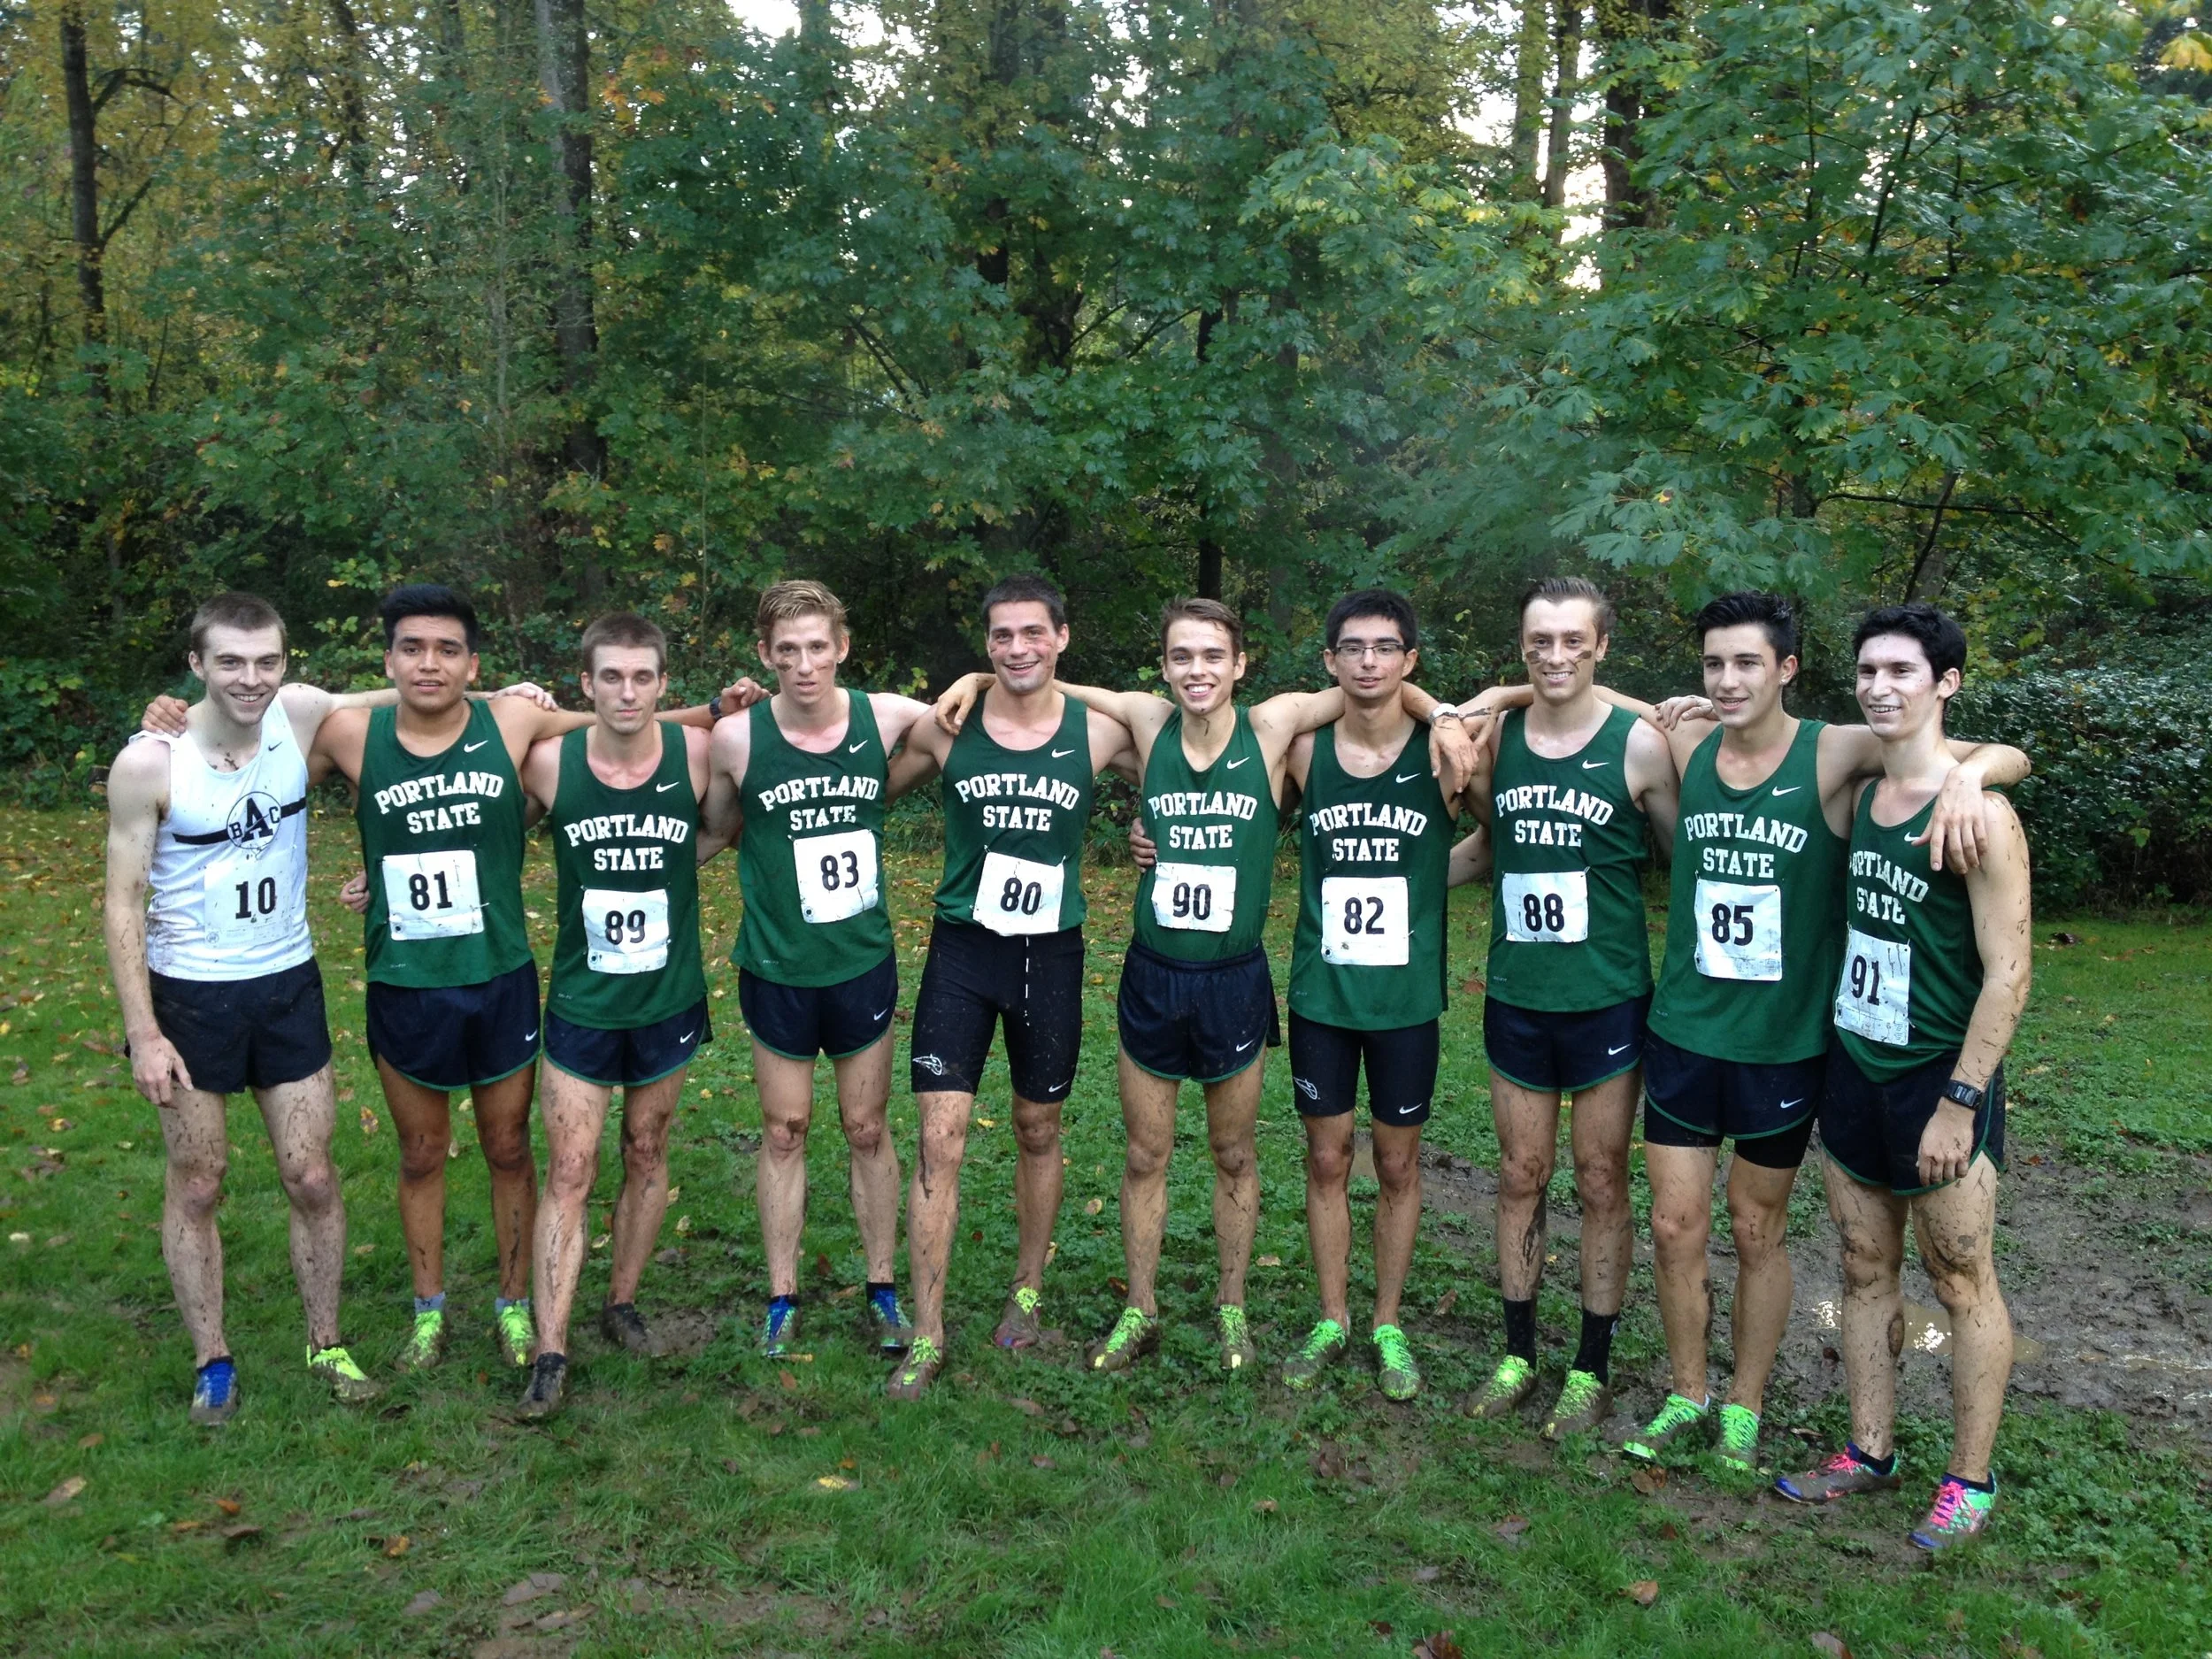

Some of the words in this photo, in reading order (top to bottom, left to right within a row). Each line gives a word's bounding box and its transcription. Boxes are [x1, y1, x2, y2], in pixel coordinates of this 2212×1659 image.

[374, 772, 504, 815] PORTLAND
[758, 775, 879, 812] PORTLAND
[955, 773, 1080, 810] PORTLAND
[1148, 791, 1258, 821] PORTLAND
[1495, 784, 1614, 826] PORTLAND
[407, 803, 481, 834] STATE
[564, 813, 689, 848] PORTLAND
[789, 804, 856, 832] STATE
[983, 805, 1052, 832] STATE
[1310, 803, 1428, 837] PORTLAND
[1514, 819, 1582, 848] STATE
[1685, 812, 1809, 854] PORTLAND
[1169, 825, 1233, 850] STATE
[1332, 837, 1400, 862] STATE
[594, 847, 664, 872] STATE
[820, 850, 859, 891] 83
[1702, 847, 1775, 879] STATE
[235, 877, 276, 919] 10
[409, 871, 453, 911] 81
[1000, 878, 1041, 916] 80
[1173, 882, 1211, 921] 90
[604, 910, 646, 945] 89
[1343, 897, 1385, 935] 82
[1523, 894, 1565, 933] 88
[1711, 903, 1754, 946] 85
[1851, 955, 1880, 1006] 91
